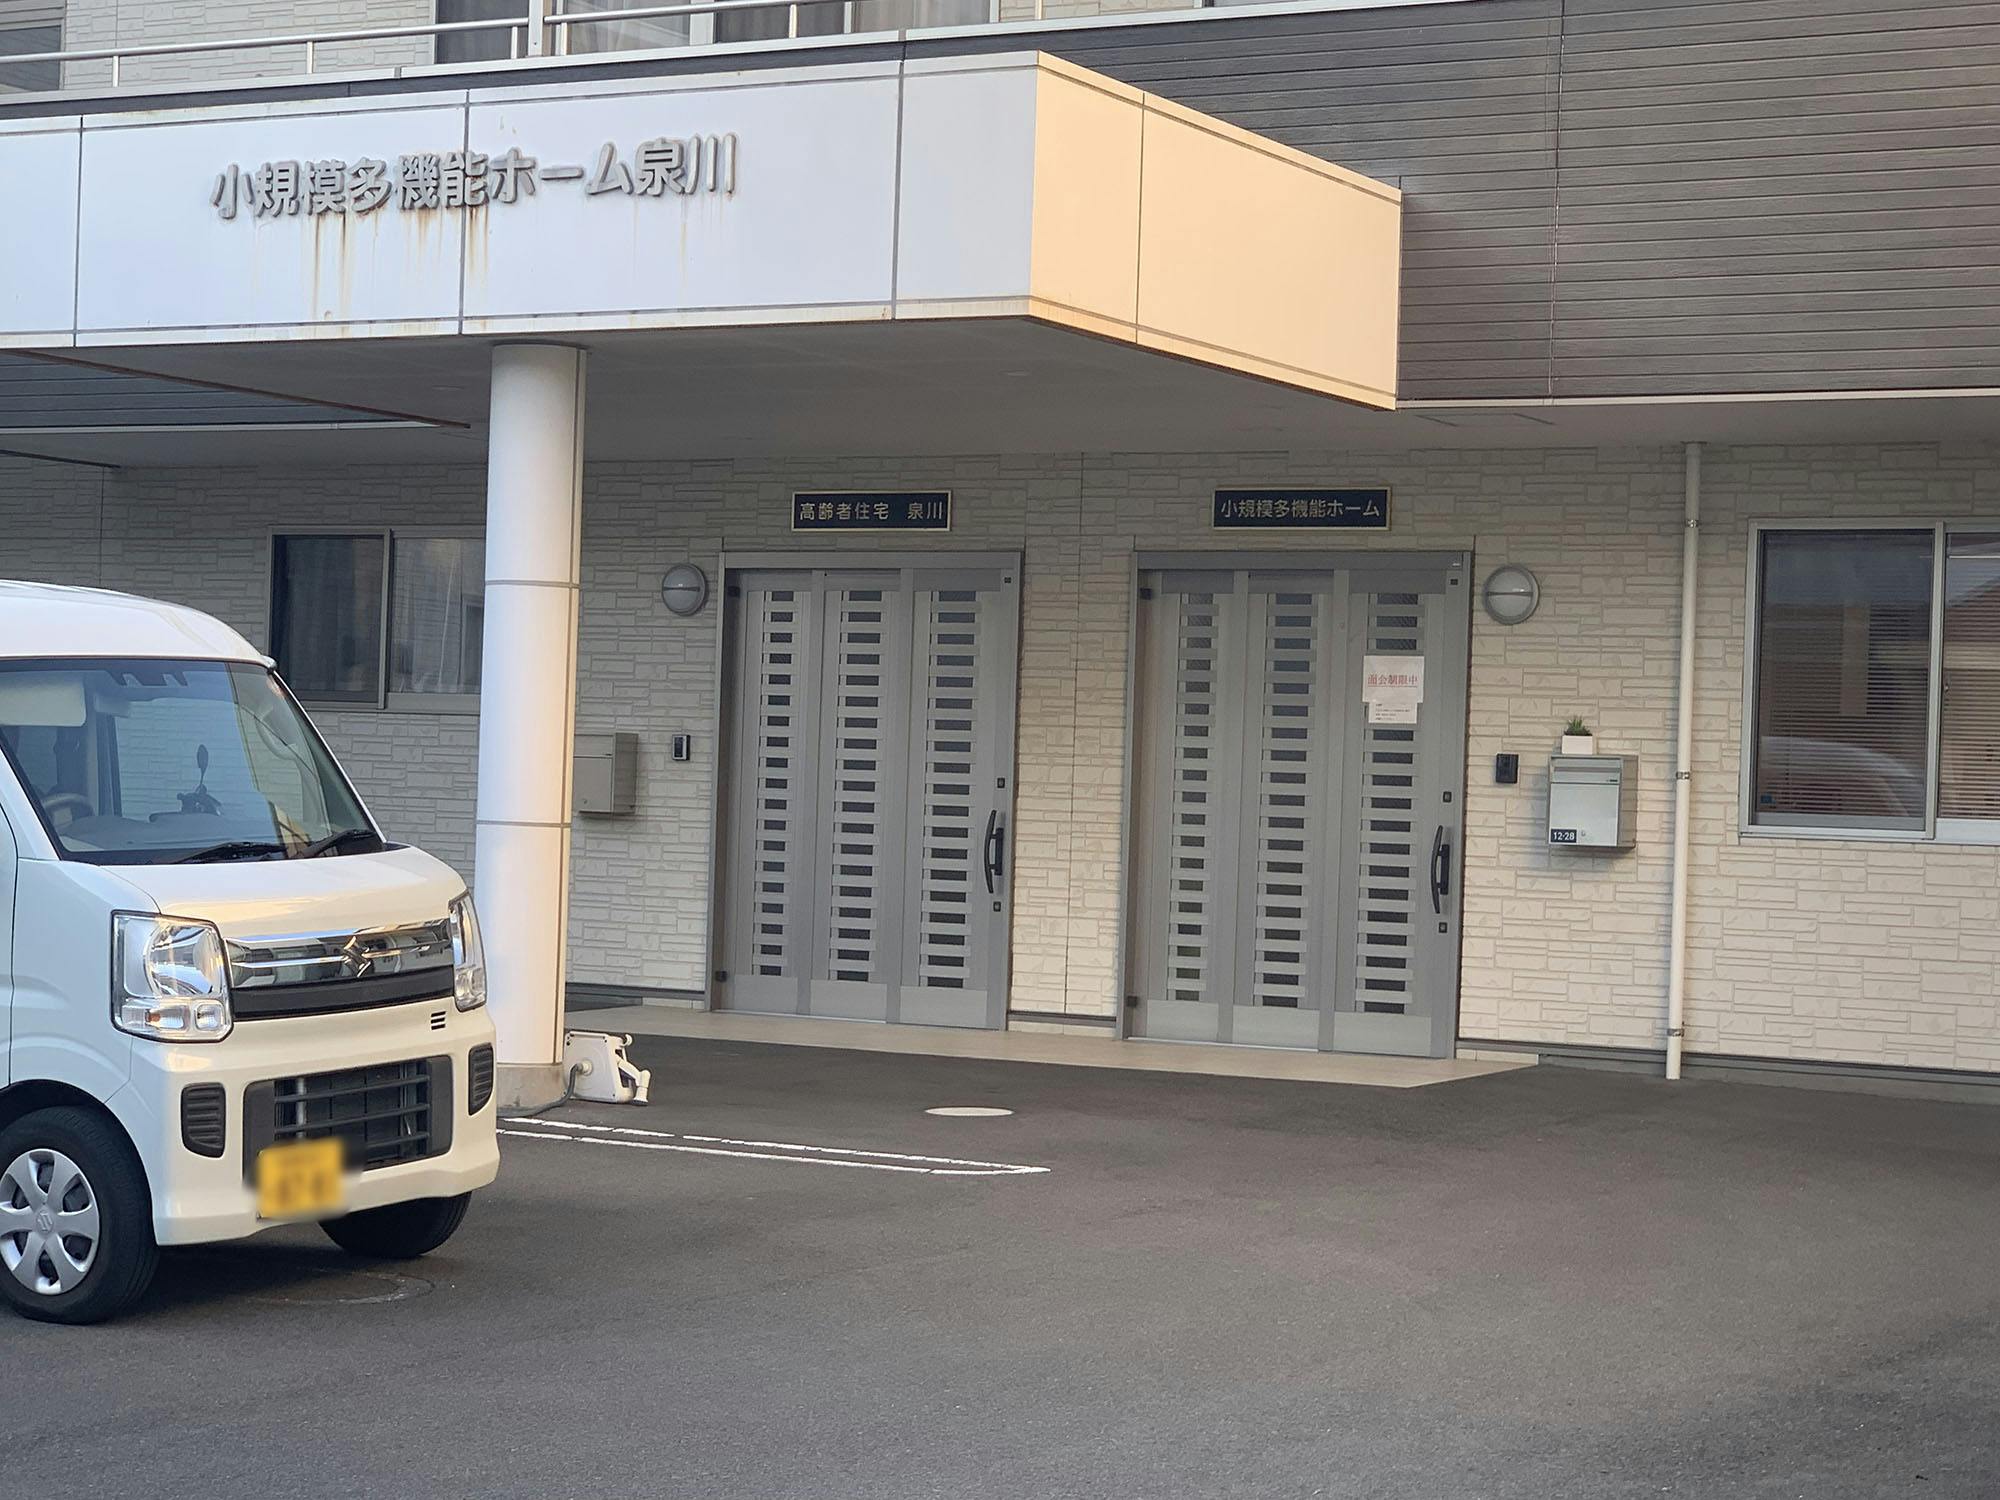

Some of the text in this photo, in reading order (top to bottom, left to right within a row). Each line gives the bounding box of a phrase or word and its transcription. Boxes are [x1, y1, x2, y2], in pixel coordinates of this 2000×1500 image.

[211, 132, 738, 219] 小規模多機能ホーム泉川
[799, 501, 943, 521] 高齢者住宅 泉川
[1220, 498, 1380, 518] 小規模多機能ホーム
